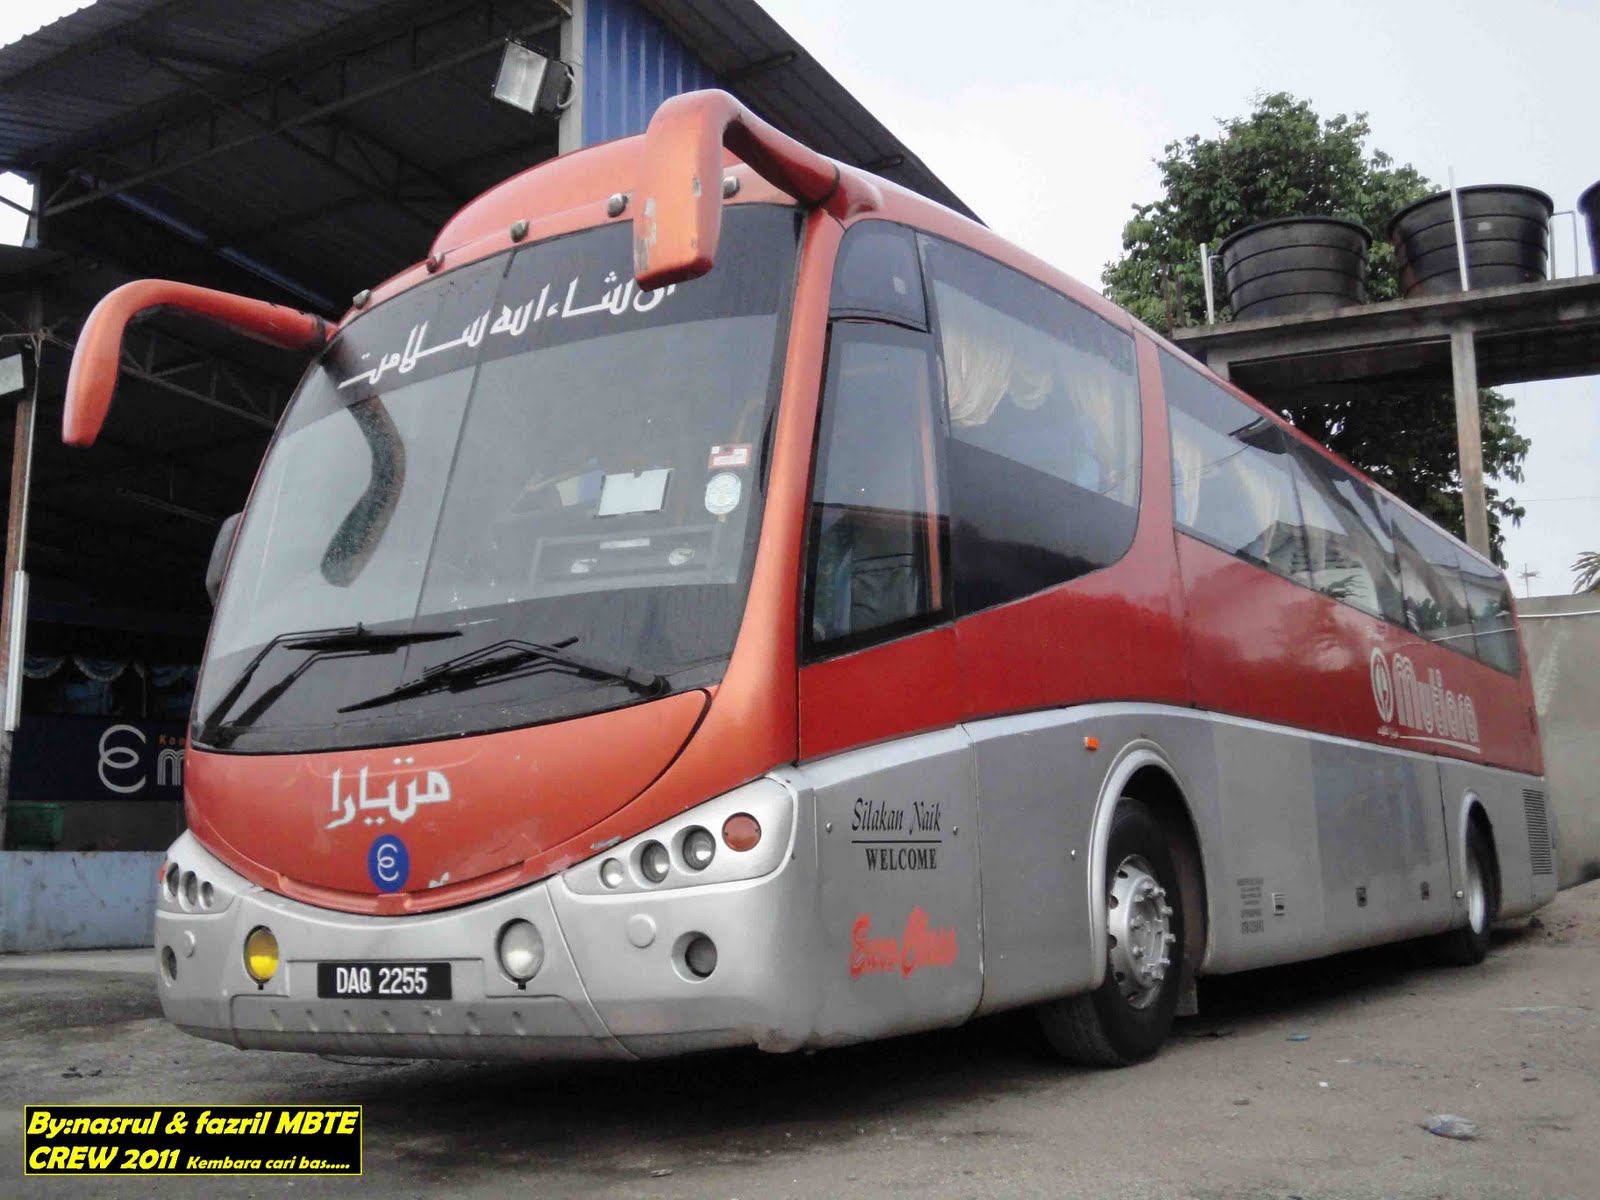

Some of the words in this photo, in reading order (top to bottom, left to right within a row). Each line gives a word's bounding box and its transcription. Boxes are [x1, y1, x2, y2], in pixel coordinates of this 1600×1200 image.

[851, 797, 904, 831] Silakan
[908, 800, 941, 835] Naik
[865, 848, 937, 871] WELCOME
[336, 967, 372, 994] DAQ
[378, 967, 428, 994] 2255
